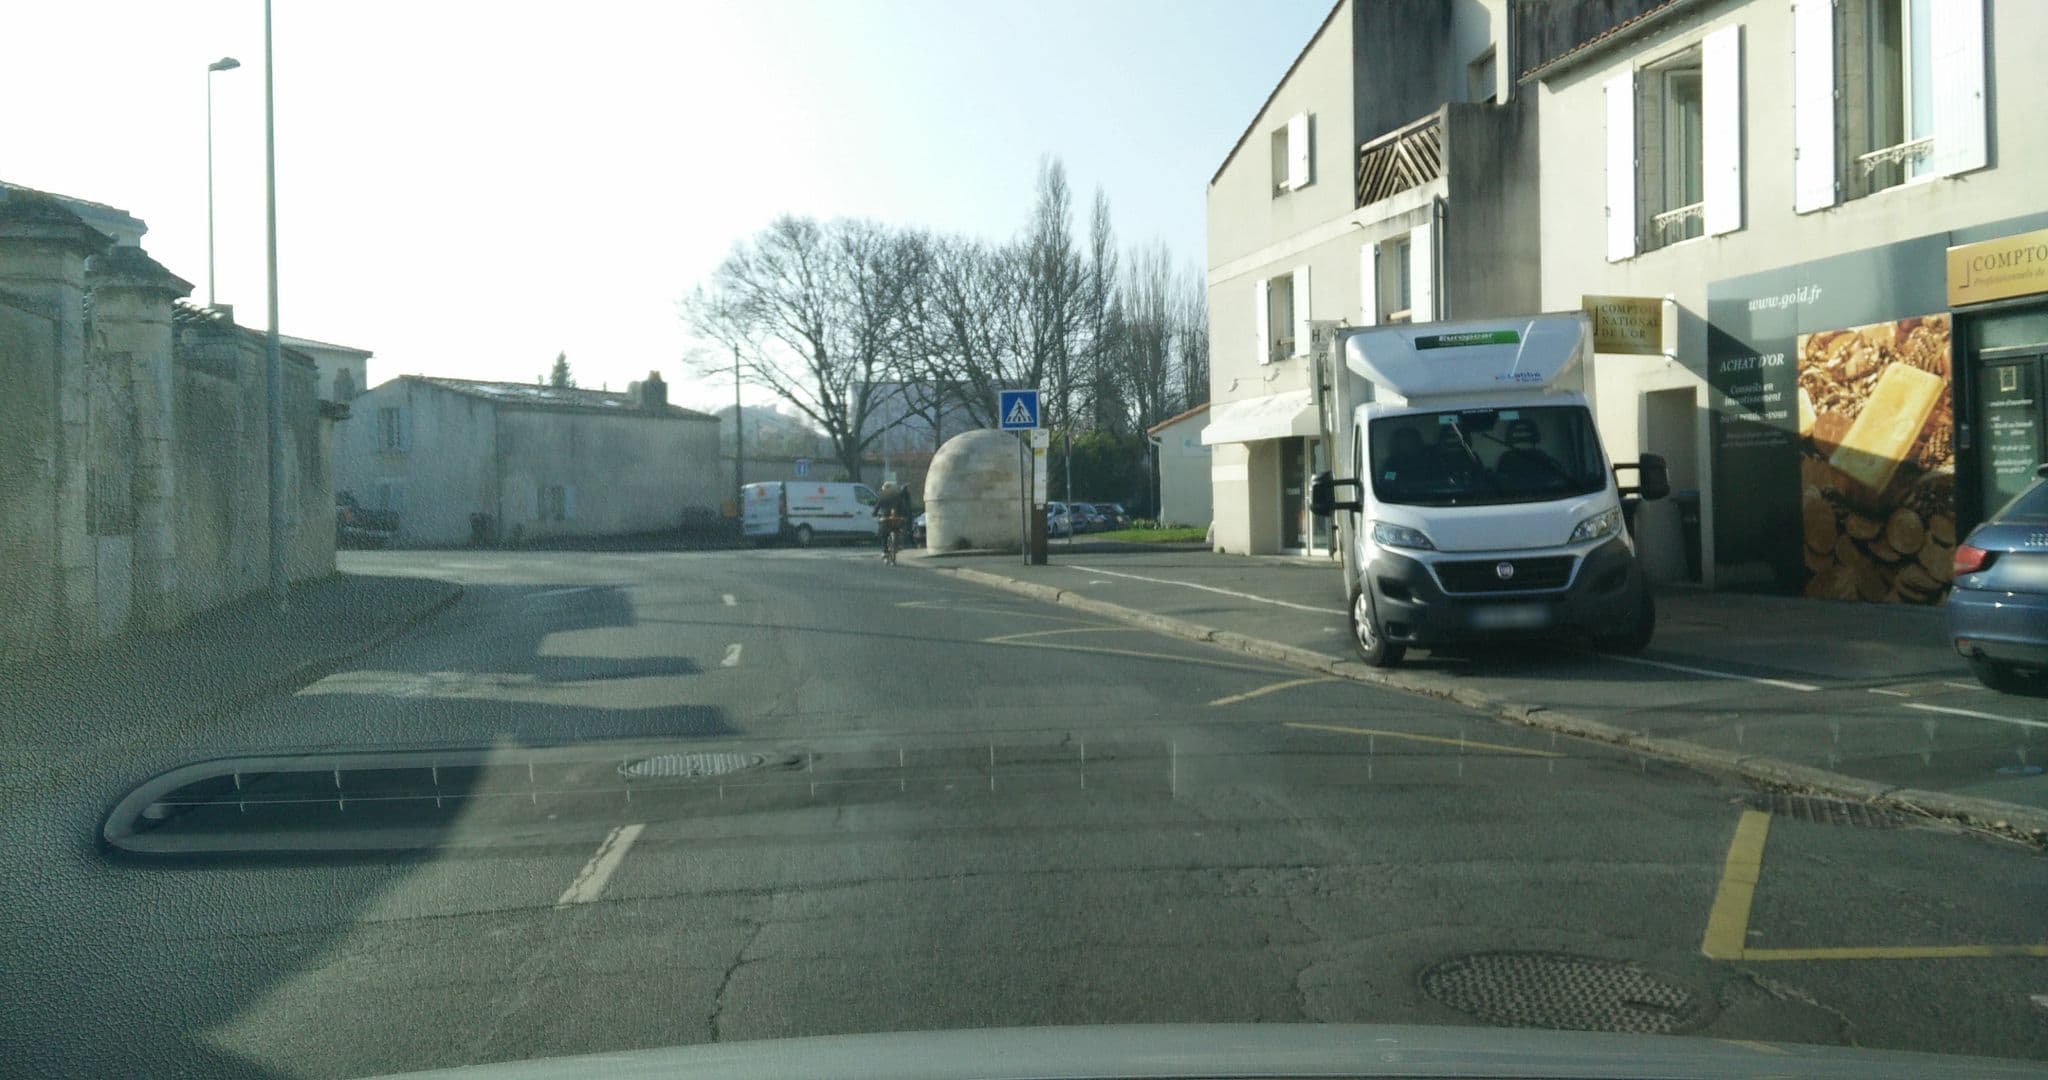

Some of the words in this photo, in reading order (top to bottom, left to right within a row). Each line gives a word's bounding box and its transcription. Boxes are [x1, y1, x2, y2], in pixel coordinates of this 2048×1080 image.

[1748, 284, 1822, 312] www.gold.fr
[1438, 333, 1495, 342] Europcar
[1720, 357, 1756, 373] ACHAT
[1760, 353, 1785, 368] D'OR
